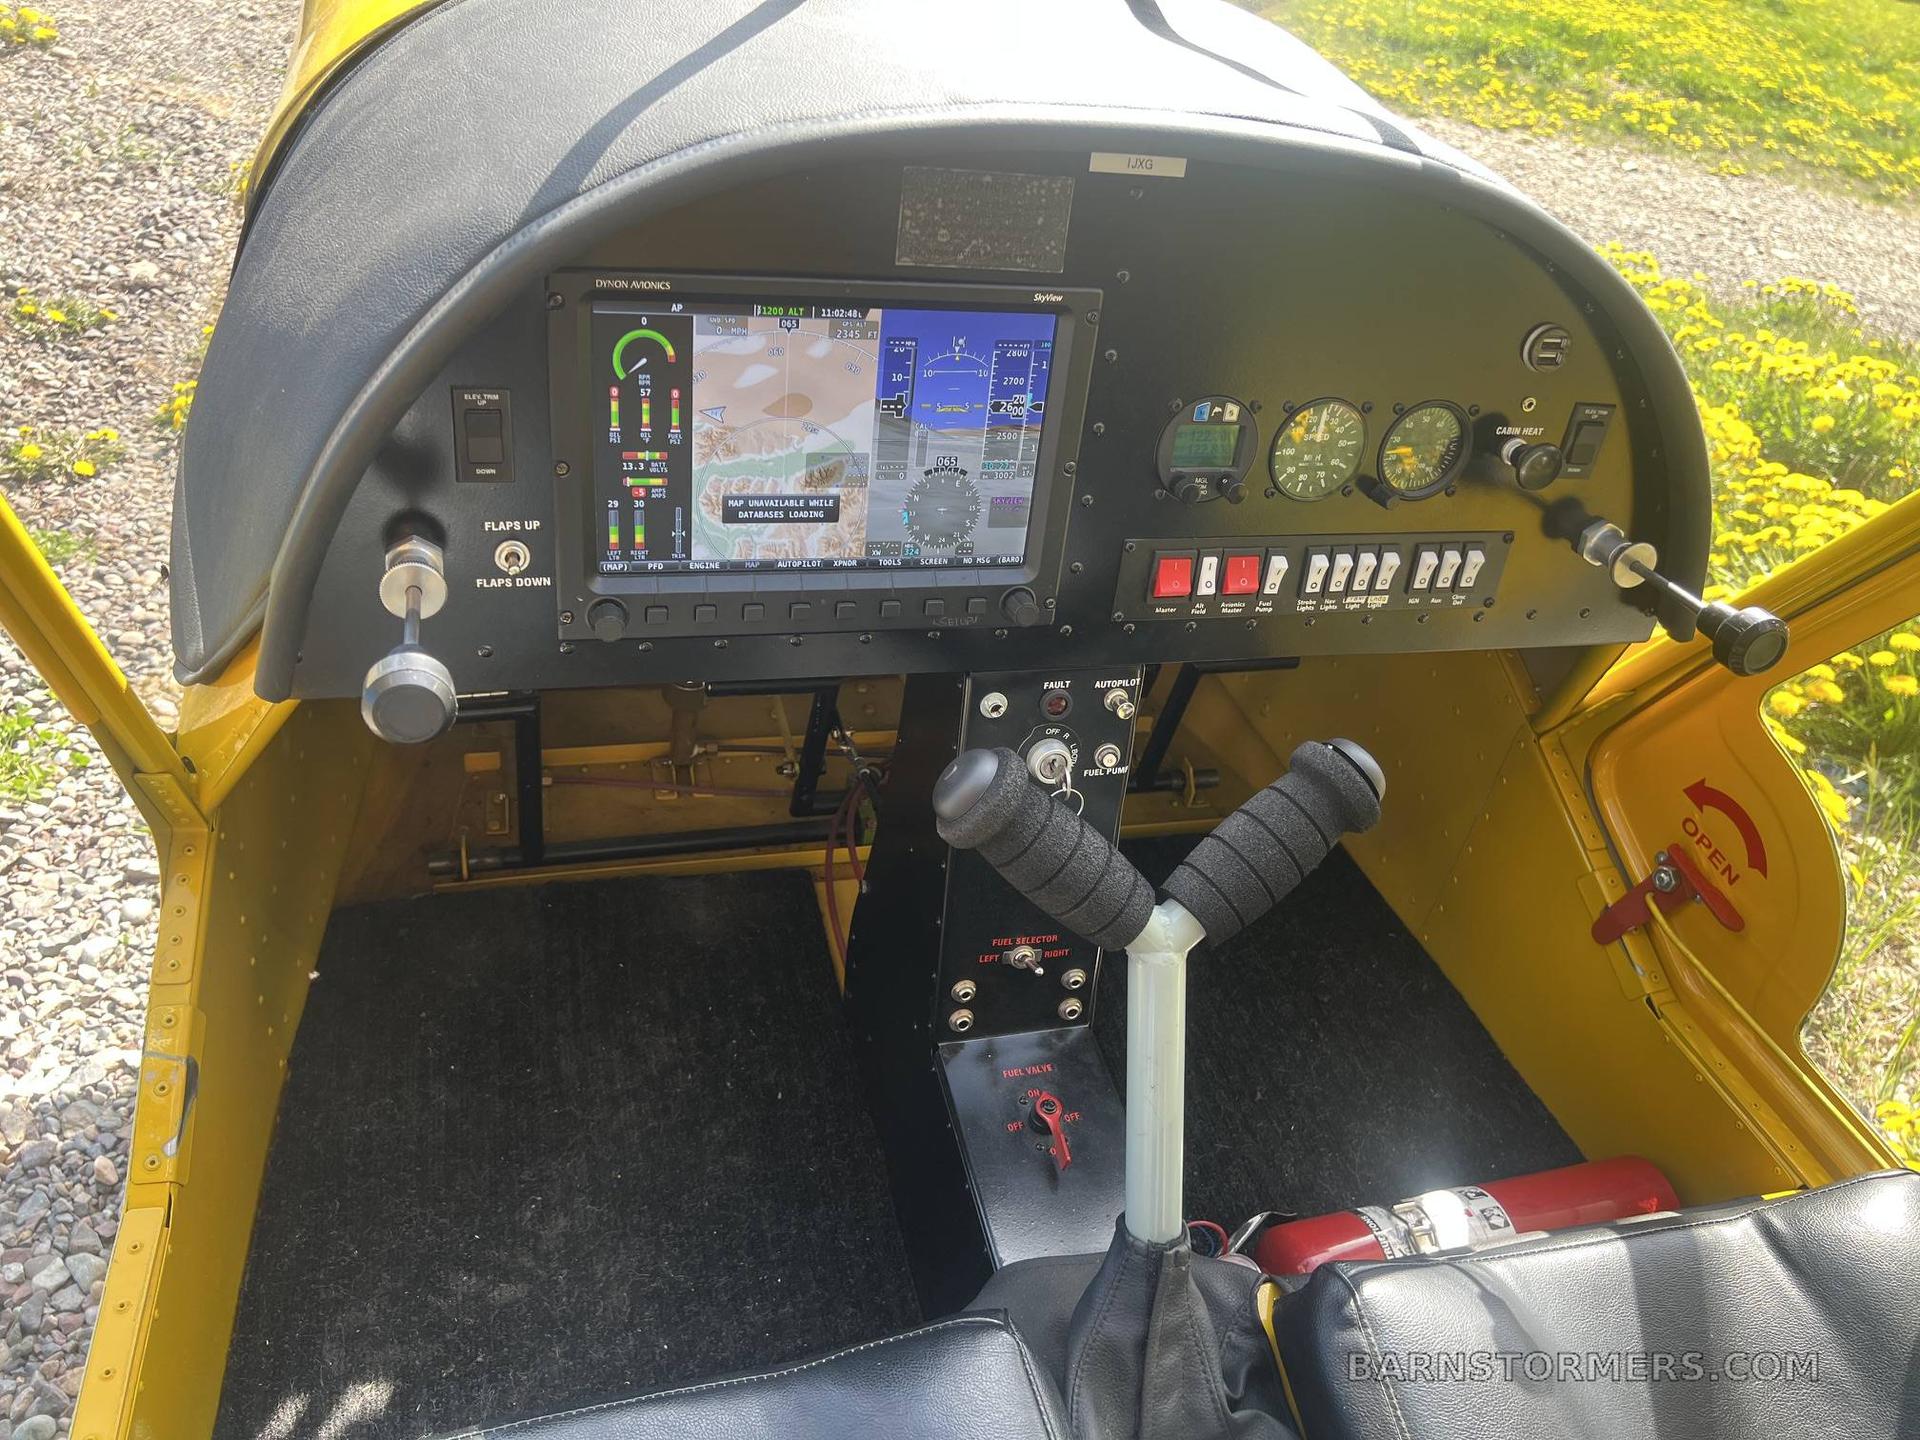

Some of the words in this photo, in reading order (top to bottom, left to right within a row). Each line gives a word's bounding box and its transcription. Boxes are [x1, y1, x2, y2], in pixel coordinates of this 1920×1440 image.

[1127, 158, 1153, 170] IJXG
[595, 279, 628, 289] DYNON
[630, 280, 671, 290] AVIONICS
[1034, 293, 1063, 302] SkyView
[671, 303, 683, 313] AP
[762, 306, 784, 315] 1200
[788, 307, 804, 316] ALT
[641, 316, 647, 325] 0
[781, 320, 797, 328] 065
[716, 326, 723, 335] 0
[731, 327, 748, 336] MPH
[836, 329, 860, 339] 2345
[867, 331, 878, 339] FT
[1042, 361, 1047, 369] 1
[892, 373, 903, 382] 10
[923, 370, 933, 378] 10
[1003, 377, 1025, 385] 2700
[483, 393, 499, 401] TRIM
[640, 388, 651, 397] 57
[1013, 395, 1025, 404] 20
[999, 401, 1012, 412] 26
[1012, 406, 1024, 416] 00
[1335, 426, 1345, 434] 40
[1496, 426, 1521, 435] CABIN
[1523, 427, 1545, 436] HEAT
[996, 432, 1018, 440] 2500
[1282, 448, 1296, 456] 100
[937, 457, 956, 466] 065
[1331, 458, 1340, 466] 60
[622, 463, 644, 471] 13.3
[1286, 466, 1296, 474] 90
[899, 472, 904, 480] 0
[994, 471, 1014, 480] 3002
[1298, 473, 1308, 482] 80
[1316, 471, 1325, 479] 70
[607, 500, 619, 508] 29
[633, 500, 645, 508] 30
[728, 499, 745, 507] MAP
[748, 499, 805, 507] UNAVAILABLE
[809, 499, 834, 507] WHILE
[738, 510, 784, 519] DATABASES
[788, 510, 824, 519] LOADING
[484, 521, 521, 531] FLAPS
[524, 520, 541, 530] UP
[966, 519, 971, 527] S
[904, 548, 919, 556] 324
[777, 560, 822, 568] AUTOPILOT
[878, 558, 902, 567] TOOLS
[920, 557, 949, 565] SCREEN
[963, 556, 973, 564] NO
[976, 556, 991, 564] MSG
[998, 555, 1024, 564] (BARO)
[603, 563, 628, 572] (MAP)
[647, 562, 664, 570] PFD
[689, 561, 721, 570] ENGINE
[745, 561, 761, 569] MAP
[476, 578, 513, 588] FLAPS
[516, 577, 551, 587] DOWN
[1296, 604, 1314, 612] Lights
[1319, 604, 1338, 612] Lights
[1043, 680, 1071, 690] FAULT
[1094, 677, 1141, 689] AUTOPILOT
[1062, 732, 1070, 740] R
[1084, 769, 1105, 777] FUEL
[1682, 817, 1740, 886] OPEN
[992, 937, 1013, 947] FUEL
[1016, 934, 1058, 945] SELECTOR
[1044, 948, 1070, 959] RIGHT
[979, 953, 1000, 964] LEFT
[1002, 1068, 1025, 1079] FUEL
[1025, 1063, 1054, 1074] VALVE
[1027, 1089, 1041, 1099] ON
[1064, 1112, 1081, 1122] OFF
[1007, 1121, 1024, 1132] OFF
